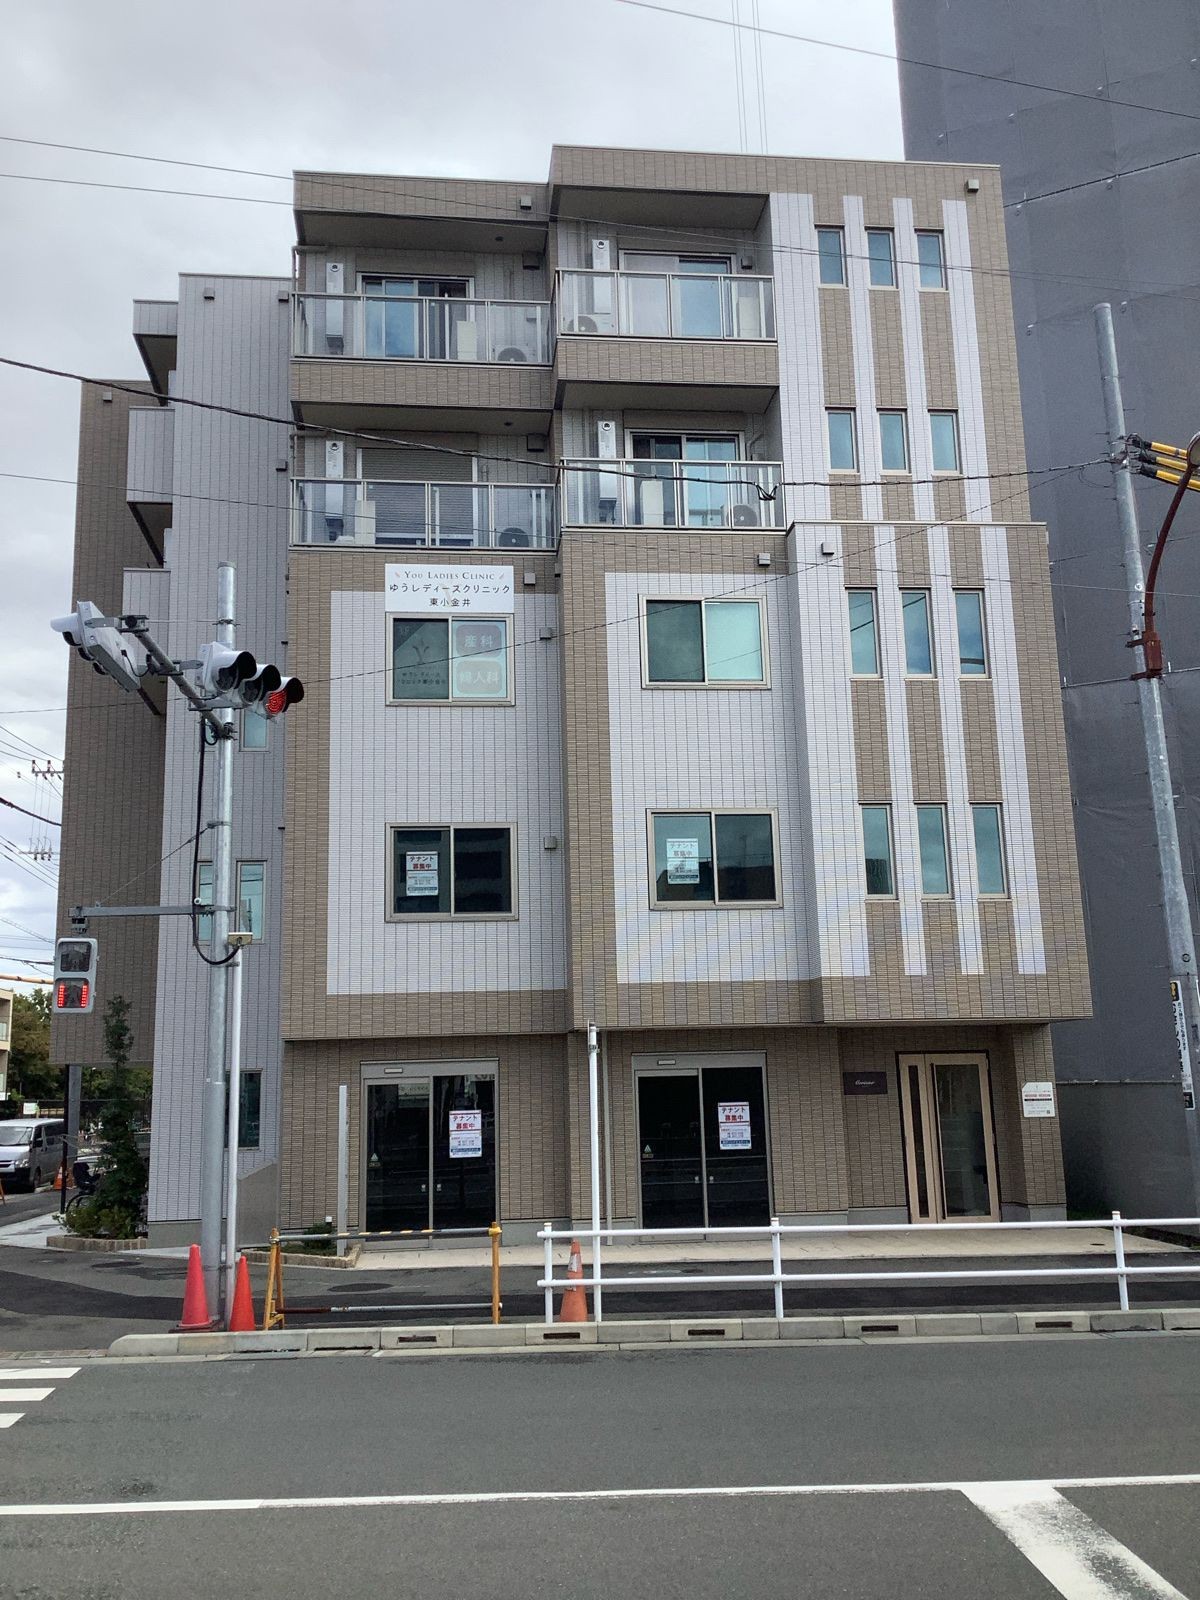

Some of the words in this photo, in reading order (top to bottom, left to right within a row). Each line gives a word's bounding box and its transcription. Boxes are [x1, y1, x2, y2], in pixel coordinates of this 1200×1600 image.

[389, 583, 510, 593] ゆうレディースクリニック
[429, 597, 471, 607] 東小金井
[464, 634, 494, 648] 産科
